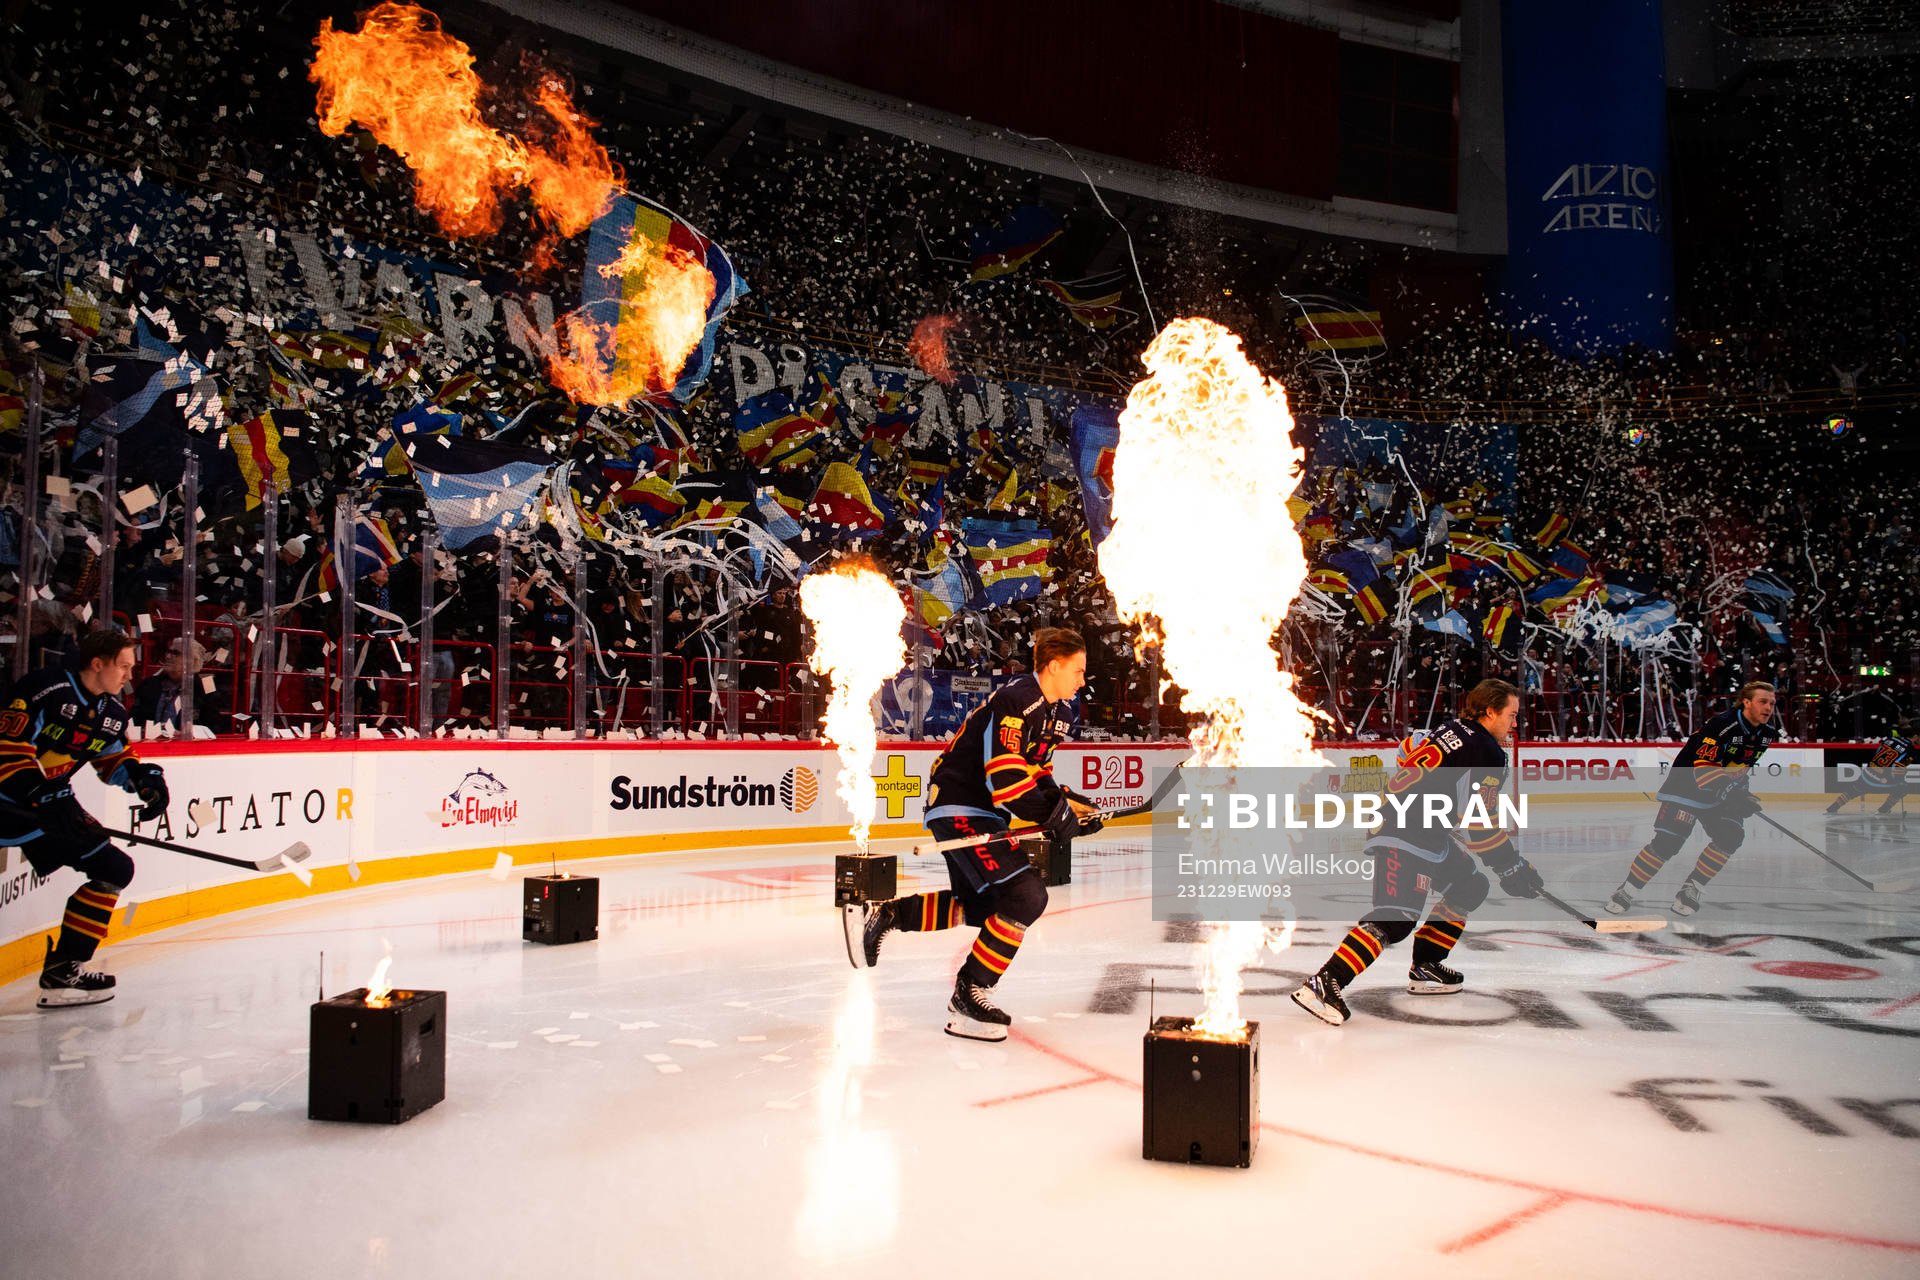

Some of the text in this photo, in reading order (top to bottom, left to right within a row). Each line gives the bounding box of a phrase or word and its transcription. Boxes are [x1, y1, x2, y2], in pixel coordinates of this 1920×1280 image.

[1000, 727, 1022, 755] 15
[1696, 743, 1719, 761] 44
[1081, 755, 1144, 790] B2B
[1522, 759, 1635, 781] BORGA
[610, 775, 775, 811] Sundström
[126, 786, 354, 847] FASTATOR
[465, 797, 518, 827] Elmqvist
[1386, 848, 1402, 898] rbus
